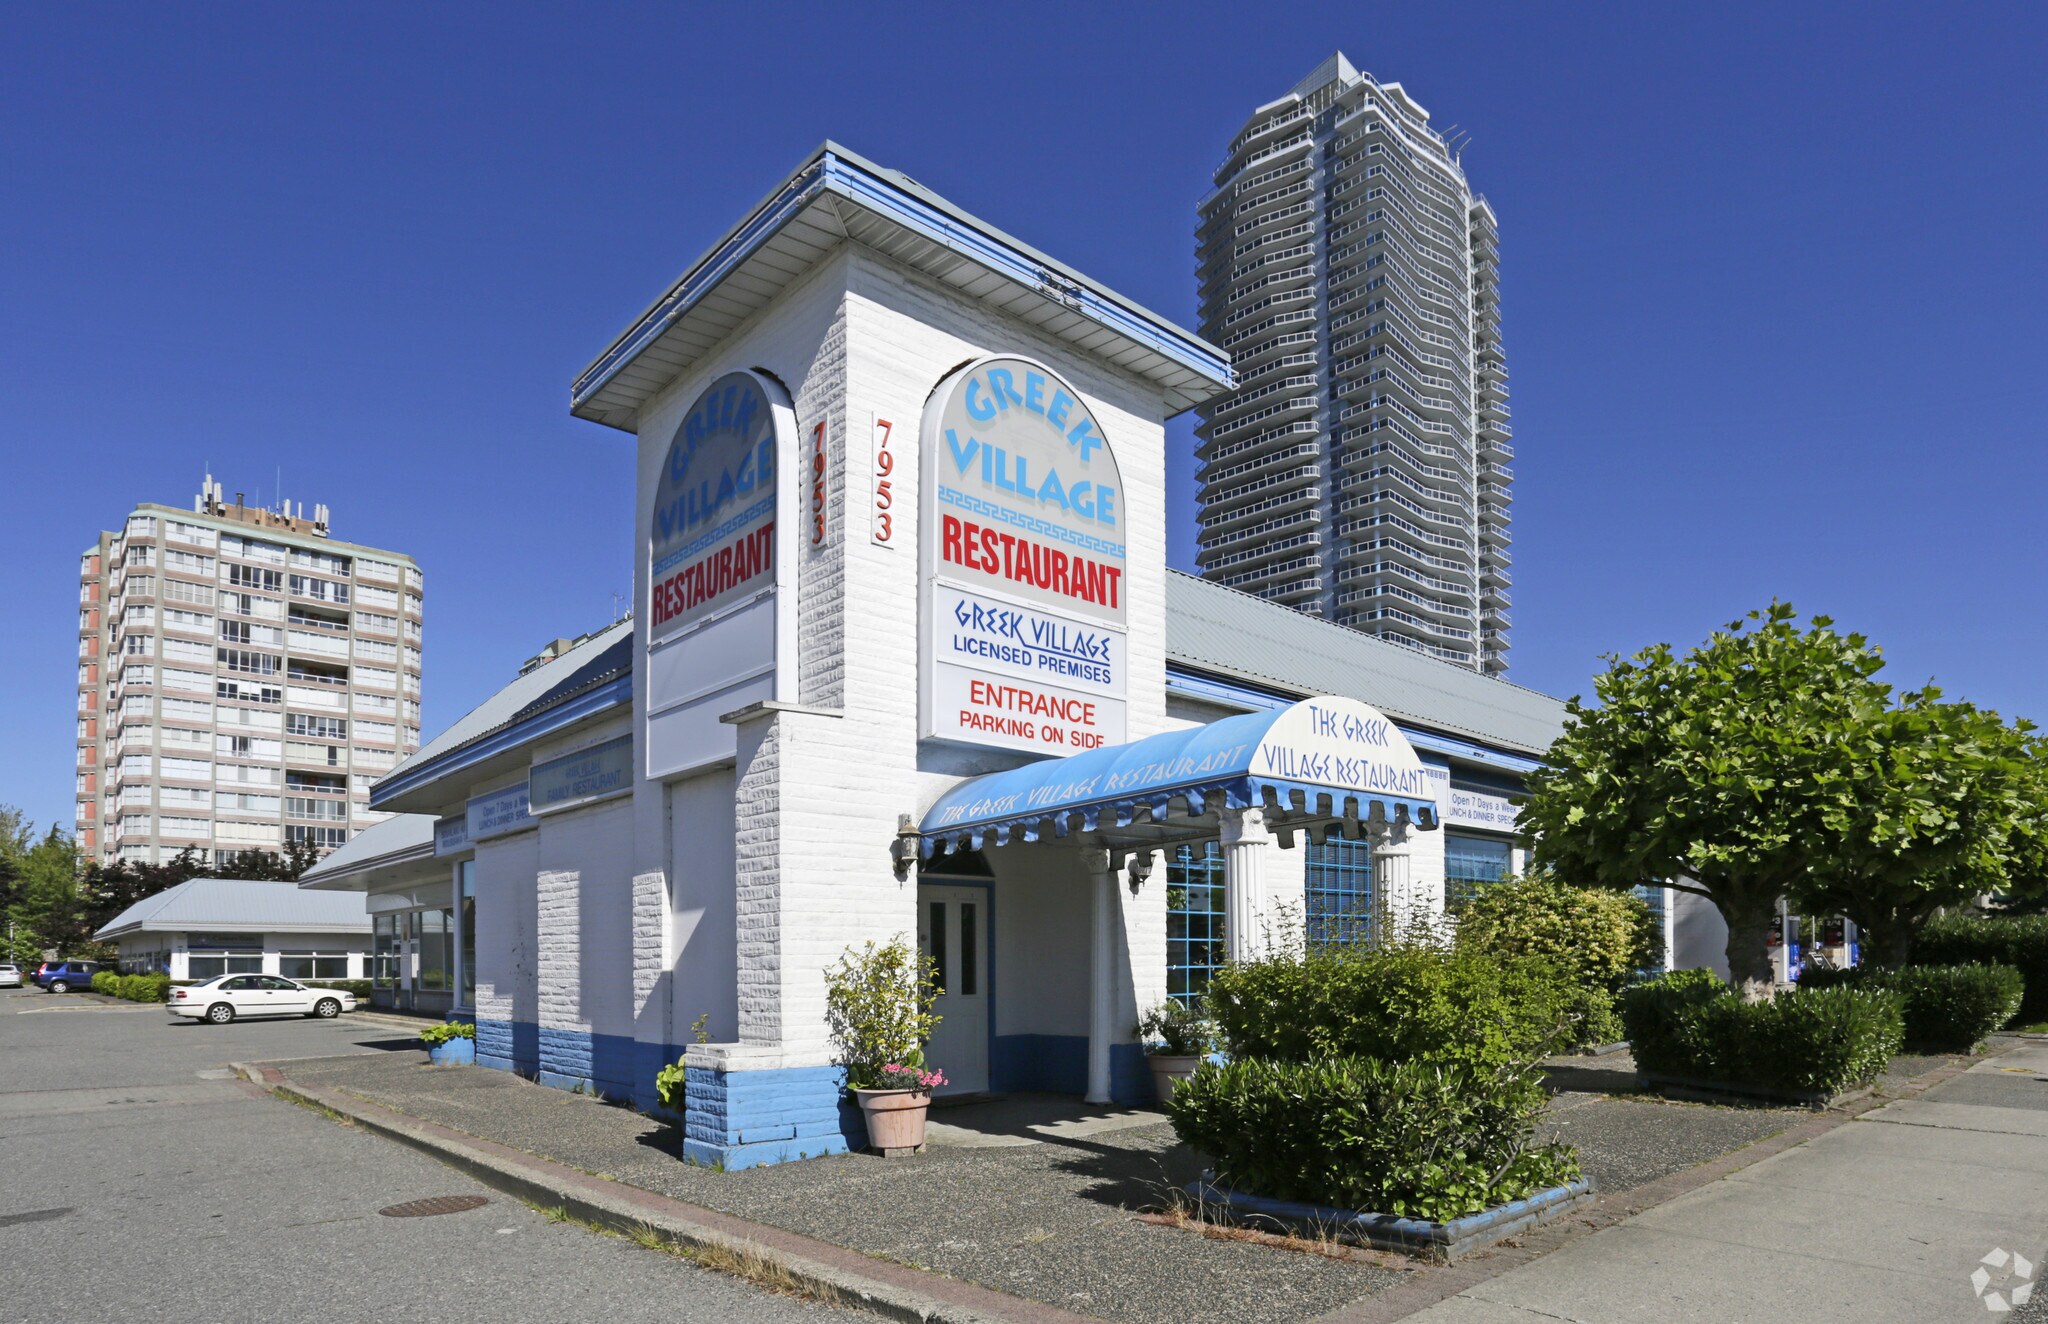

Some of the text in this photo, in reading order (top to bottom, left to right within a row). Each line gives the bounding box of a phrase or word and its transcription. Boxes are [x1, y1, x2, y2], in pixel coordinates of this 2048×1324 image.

[671, 383, 758, 482] GREEK
[965, 368, 1103, 463] GREEK
[658, 436, 773, 541] VILLAGE
[812, 421, 827, 545] 7953
[875, 418, 894, 542] 7953
[944, 428, 1116, 526] VILLAGE
[652, 521, 774, 627] RESTAURANT
[942, 513, 1121, 609] RESTAURANT
[953, 634, 1111, 684] LICENSED PREMISES
[954, 599, 1111, 662] GREEK VILLAGE
[959, 710, 1104, 749] PARKING ON SIDE
[970, 679, 1096, 726] ENTRANCE
[1309, 705, 1389, 747] THE GREEK
[938, 744, 1248, 824] THE GREEK VILLAGE RESTAURANT
[1263, 743, 1425, 795] VILLAGE RESTAURANT
[1452, 793, 1470, 806] Open
[1478, 798, 1493, 811] Days
[1449, 806, 1467, 818] UNCH
[1473, 810, 1495, 822] DINNER
